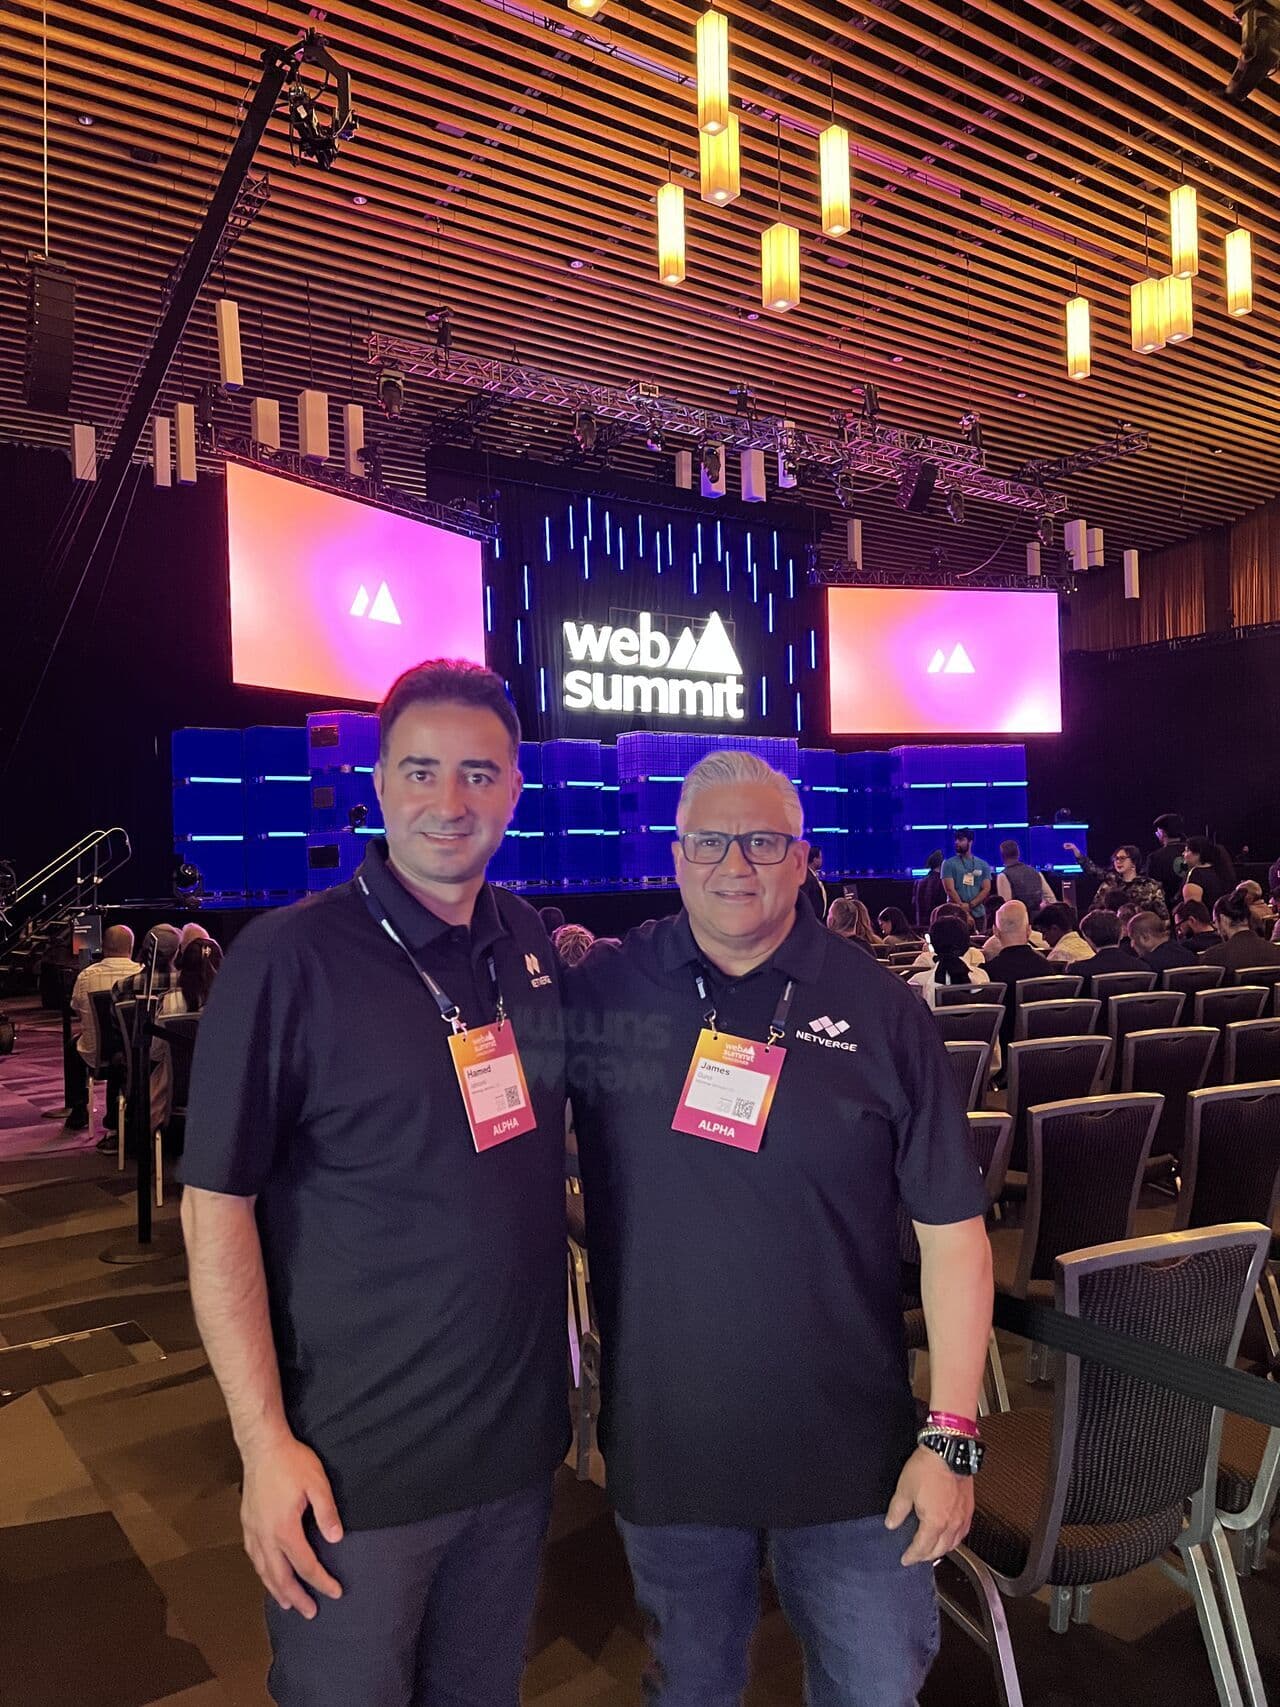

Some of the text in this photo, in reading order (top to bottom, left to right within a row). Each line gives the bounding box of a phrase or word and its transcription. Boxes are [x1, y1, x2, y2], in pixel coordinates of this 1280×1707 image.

[563, 612, 671, 668] web
[563, 670, 745, 719] summit
[795, 1030, 858, 1052] NETVERGE
[723, 1049, 755, 1063] summit
[466, 1065, 492, 1079] Hamed
[701, 1062, 730, 1076] James
[493, 1117, 520, 1137] ALPHA
[698, 1119, 736, 1139] ALPHA
